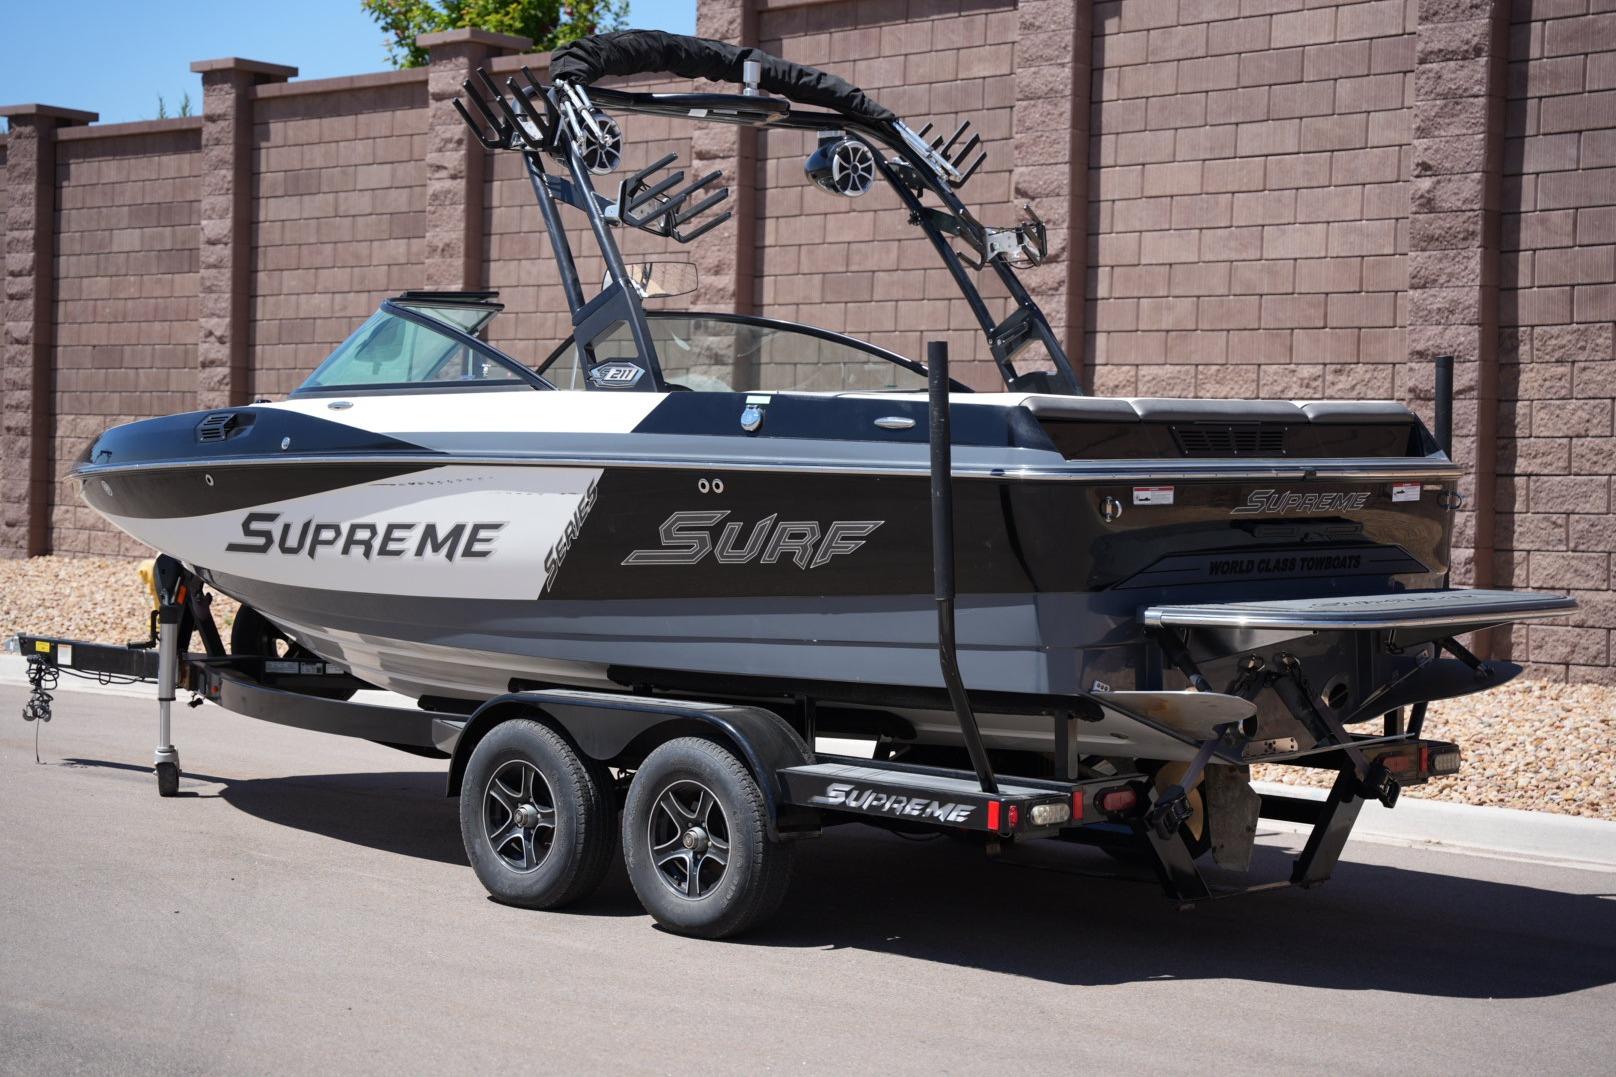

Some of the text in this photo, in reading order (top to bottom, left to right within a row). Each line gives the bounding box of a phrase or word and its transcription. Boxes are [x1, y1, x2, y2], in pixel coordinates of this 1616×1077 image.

[1230, 489, 1371, 515] SUPREME
[225, 511, 506, 561] SUPREME
[544, 477, 598, 593] SERIES
[620, 510, 885, 570] SURF
[1209, 554, 1361, 576] WORLD CLASS TOWBOATS
[808, 782, 977, 823] SUPREME
